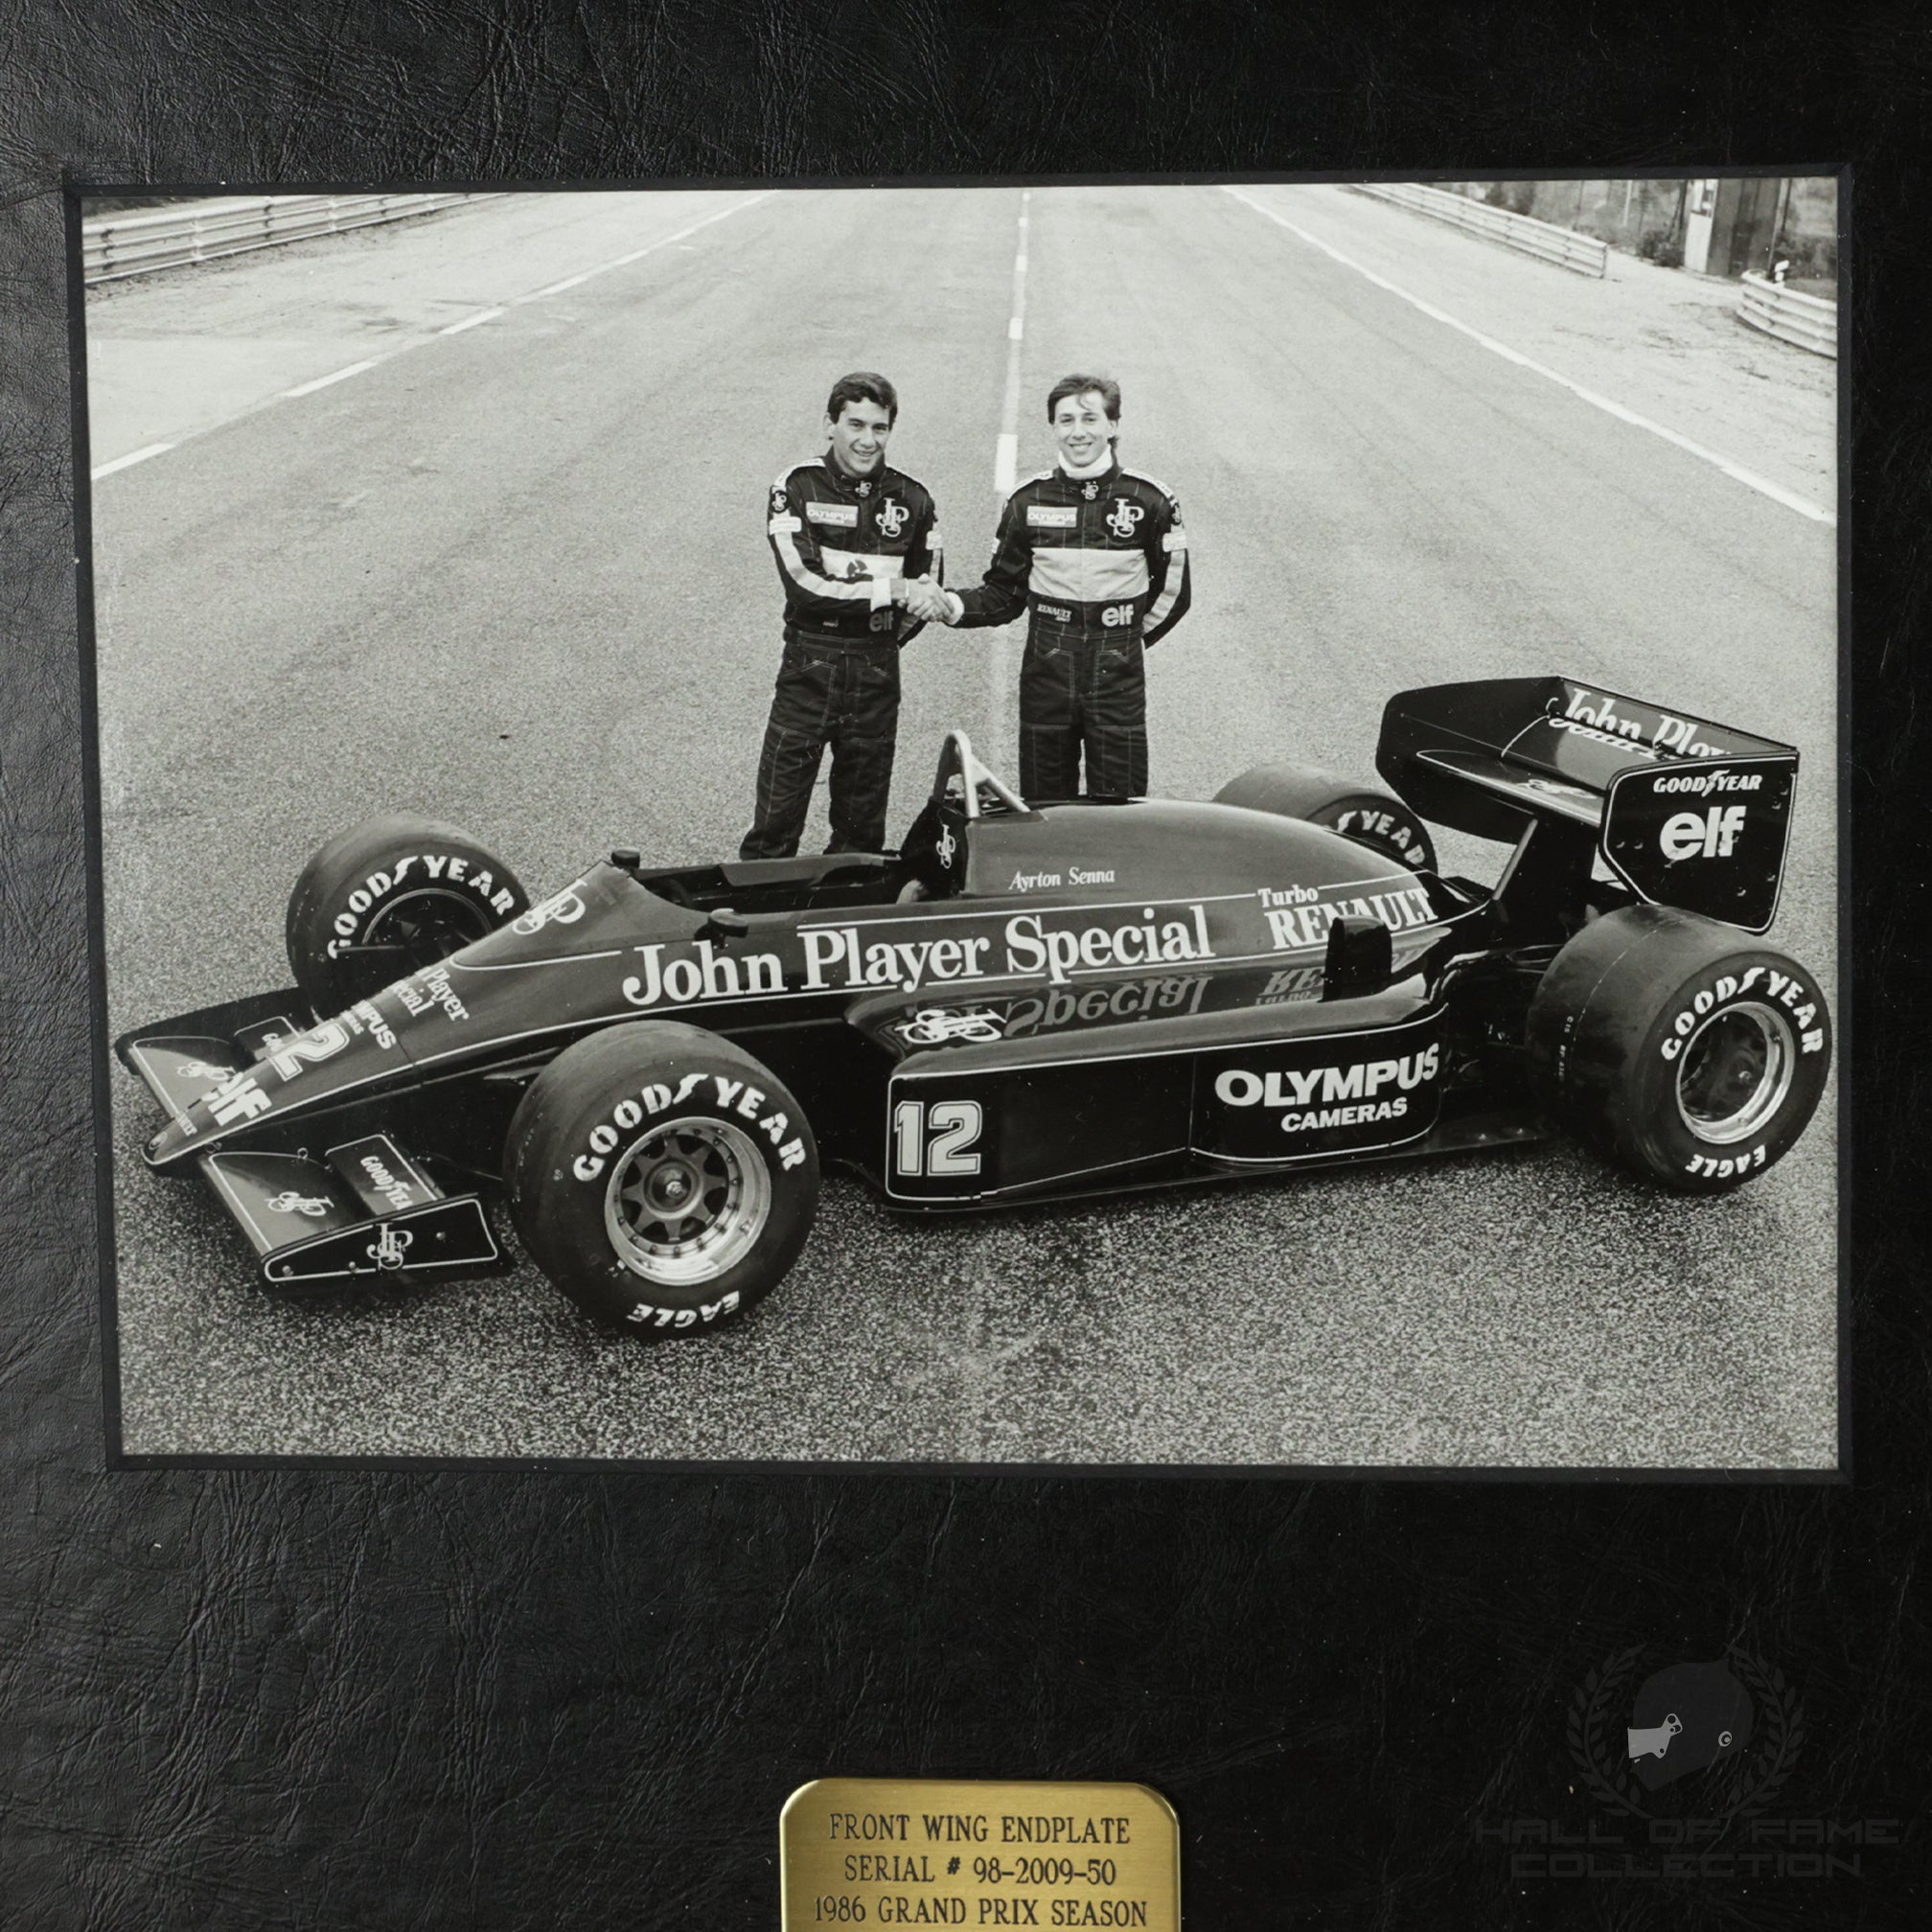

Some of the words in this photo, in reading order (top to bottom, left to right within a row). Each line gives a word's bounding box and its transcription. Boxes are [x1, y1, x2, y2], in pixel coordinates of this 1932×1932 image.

[807, 508, 858, 523] OLYMPUS
[1027, 513, 1077, 522] OLYMPUS
[869, 610, 895, 632] elf
[1101, 604, 1134, 628] elf
[1653, 770, 1763, 797] GOODYEAR
[1660, 806, 1746, 861] elf
[1009, 870, 1061, 892] Ayrton
[1069, 866, 1116, 886] Senna
[1257, 885, 1319, 908] Turbo
[622, 940, 788, 1005] John
[798, 929, 990, 993] Player
[1006, 905, 1216, 985] Special
[422, 968, 470, 1021] Player
[1661, 967, 1824, 1061] GOODYEAR
[1214, 1043, 1439, 1108] OLYMPUS
[573, 1073, 807, 1182] GOODYEAR
[1281, 1096, 1408, 1133] CAMERAS
[894, 1100, 982, 1177] 12
[1685, 1144, 1766, 1179] EAGLE
[360, 1155, 414, 1210] GOODYEA
[626, 1290, 741, 1328] EAGLE
[829, 1812, 910, 1841] FRONT
[922, 1814, 988, 1843] WING
[1000, 1816, 1131, 1844] ENDPLATE
[844, 1855, 935, 1882] SERIAL
[946, 1856, 961, 1876] #
[973, 1857, 1116, 1886] 98-2009-50
[815, 1897, 865, 1922] 1986
[878, 1897, 967, 1923] GRAND
[978, 1898, 1038, 1925] PRIX
[1051, 1899, 1149, 1927] SEASON
